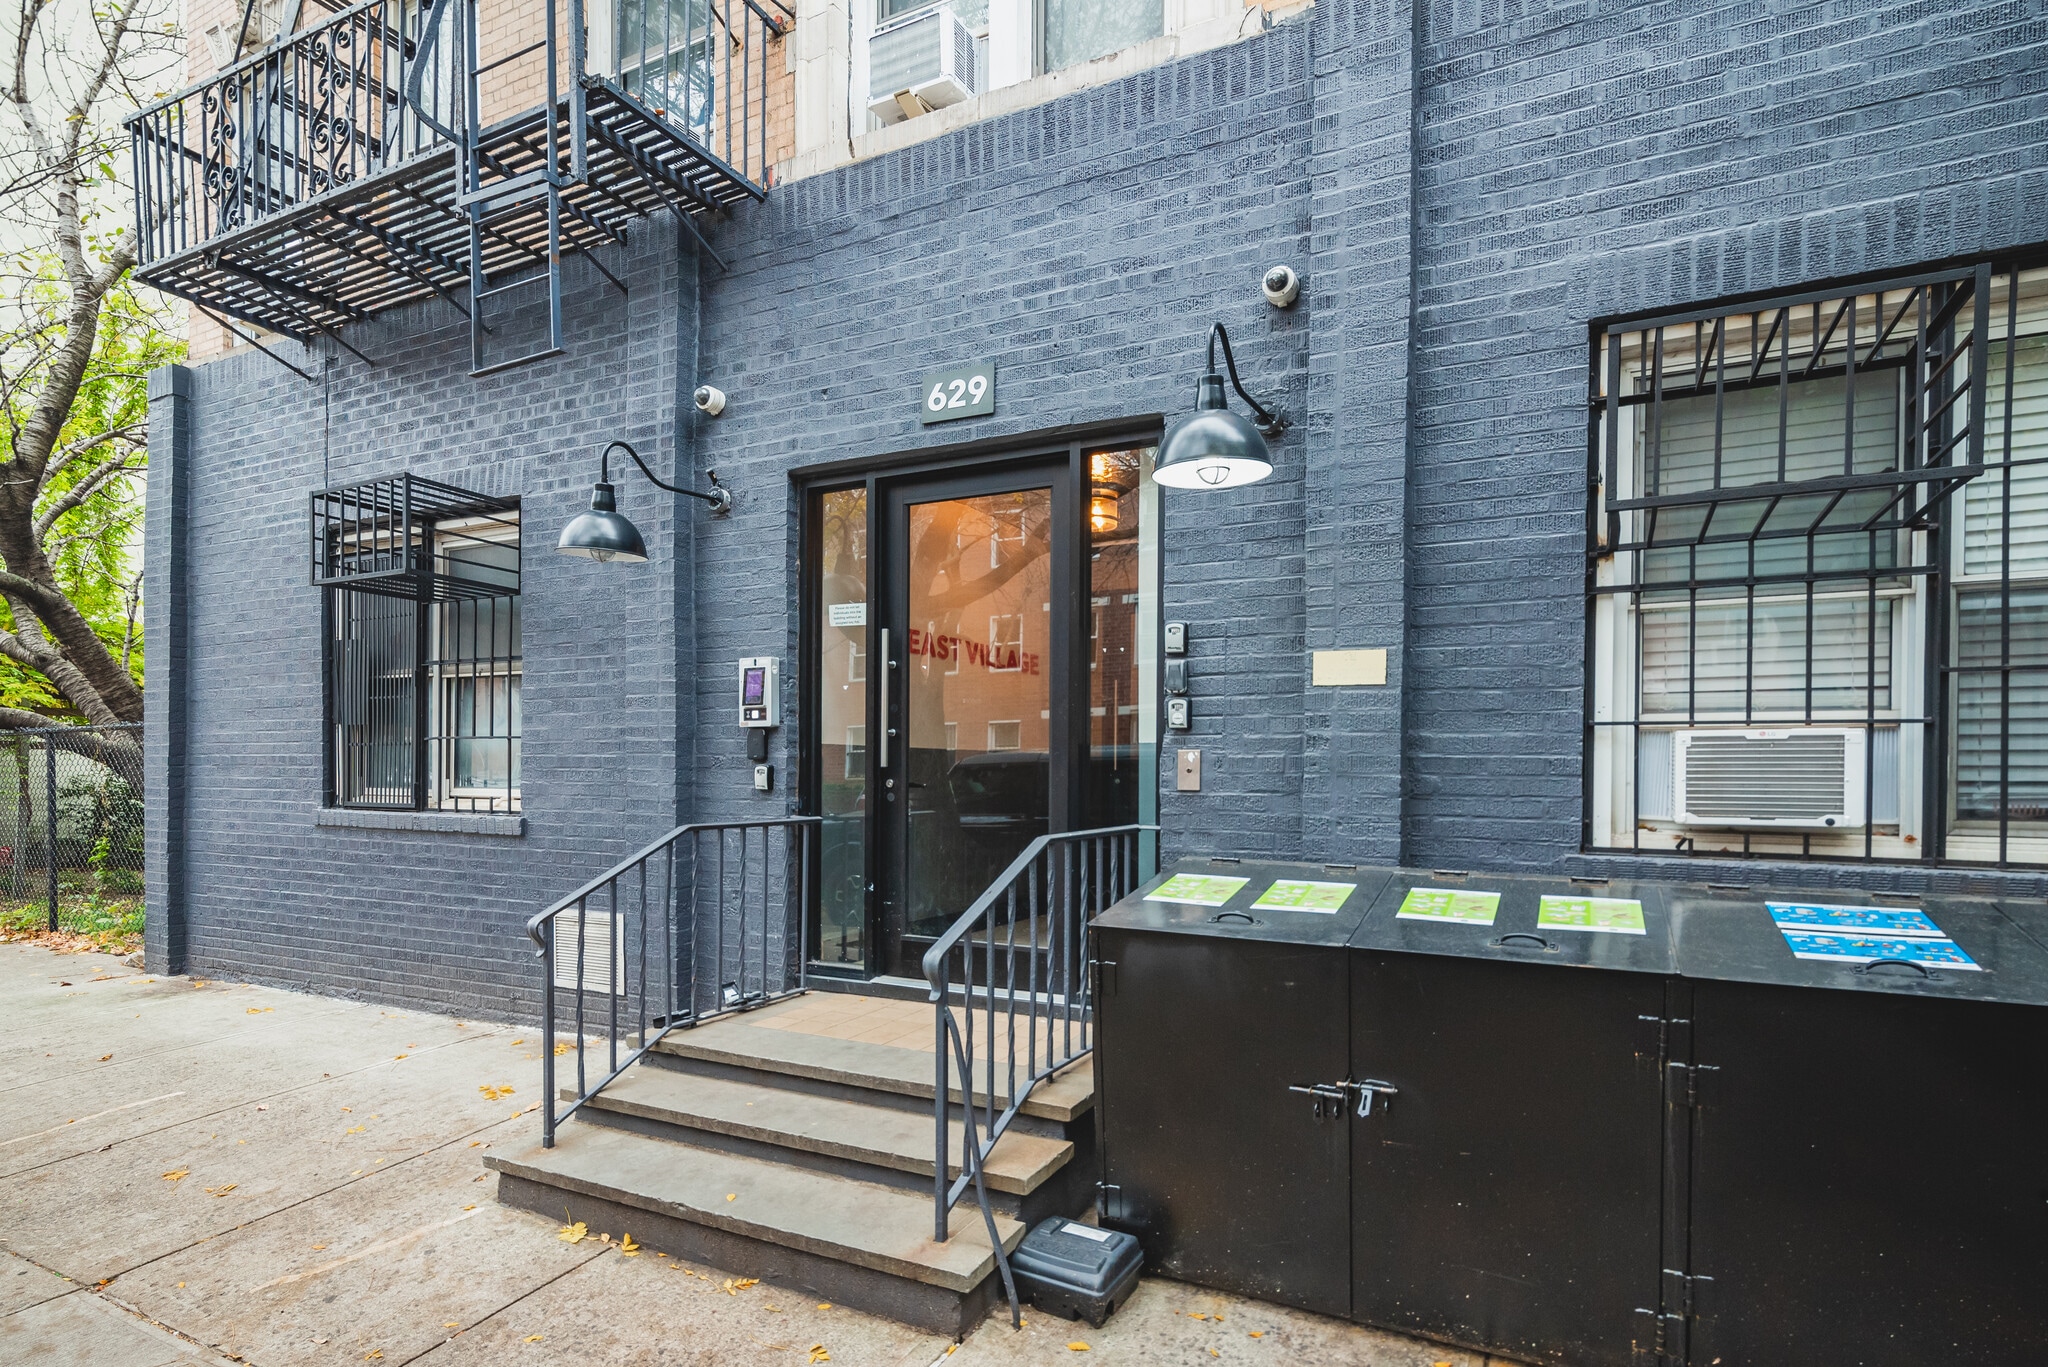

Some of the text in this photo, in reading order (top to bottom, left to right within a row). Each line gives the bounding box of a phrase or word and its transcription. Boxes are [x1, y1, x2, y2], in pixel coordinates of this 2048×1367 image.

[928, 375, 988, 412] 629
[909, 629, 1040, 675] EAST VILLAGE
